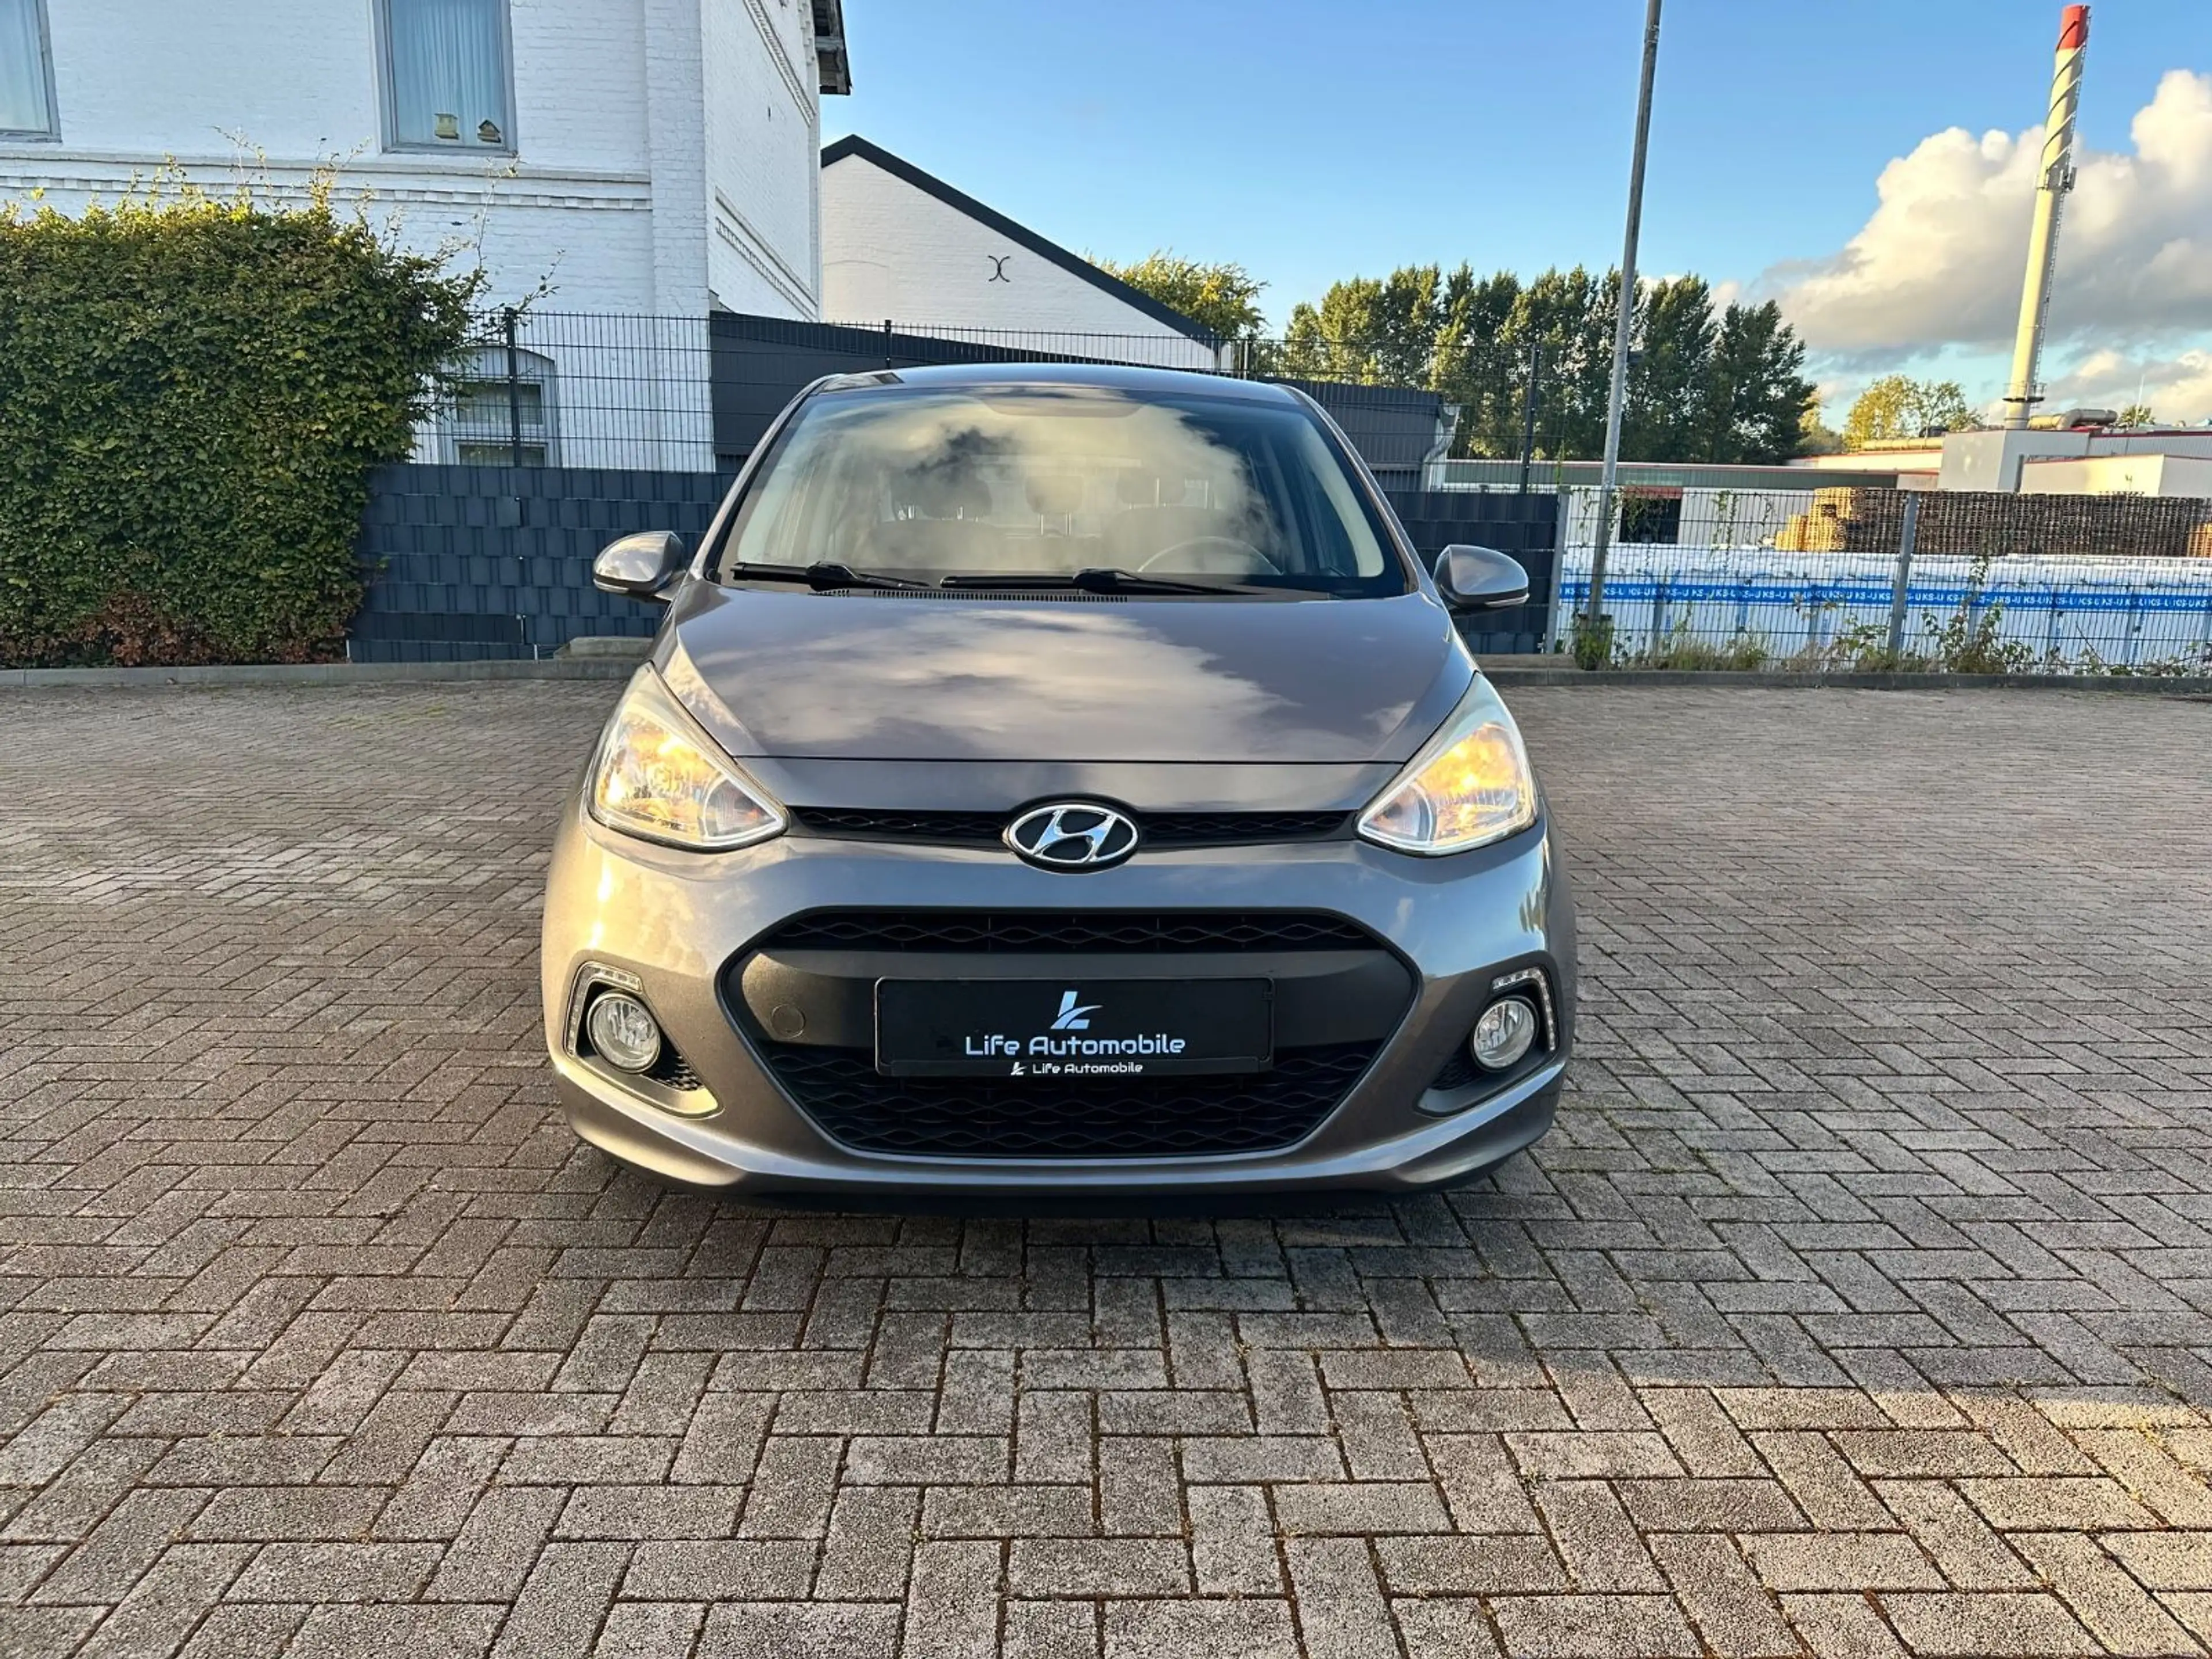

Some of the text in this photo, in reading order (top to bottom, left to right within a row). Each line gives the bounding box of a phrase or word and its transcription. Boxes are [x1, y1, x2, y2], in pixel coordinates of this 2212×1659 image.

[965, 1033, 1186, 1056] Life Automobile
[1032, 1061, 1143, 1074] Life Automobile
